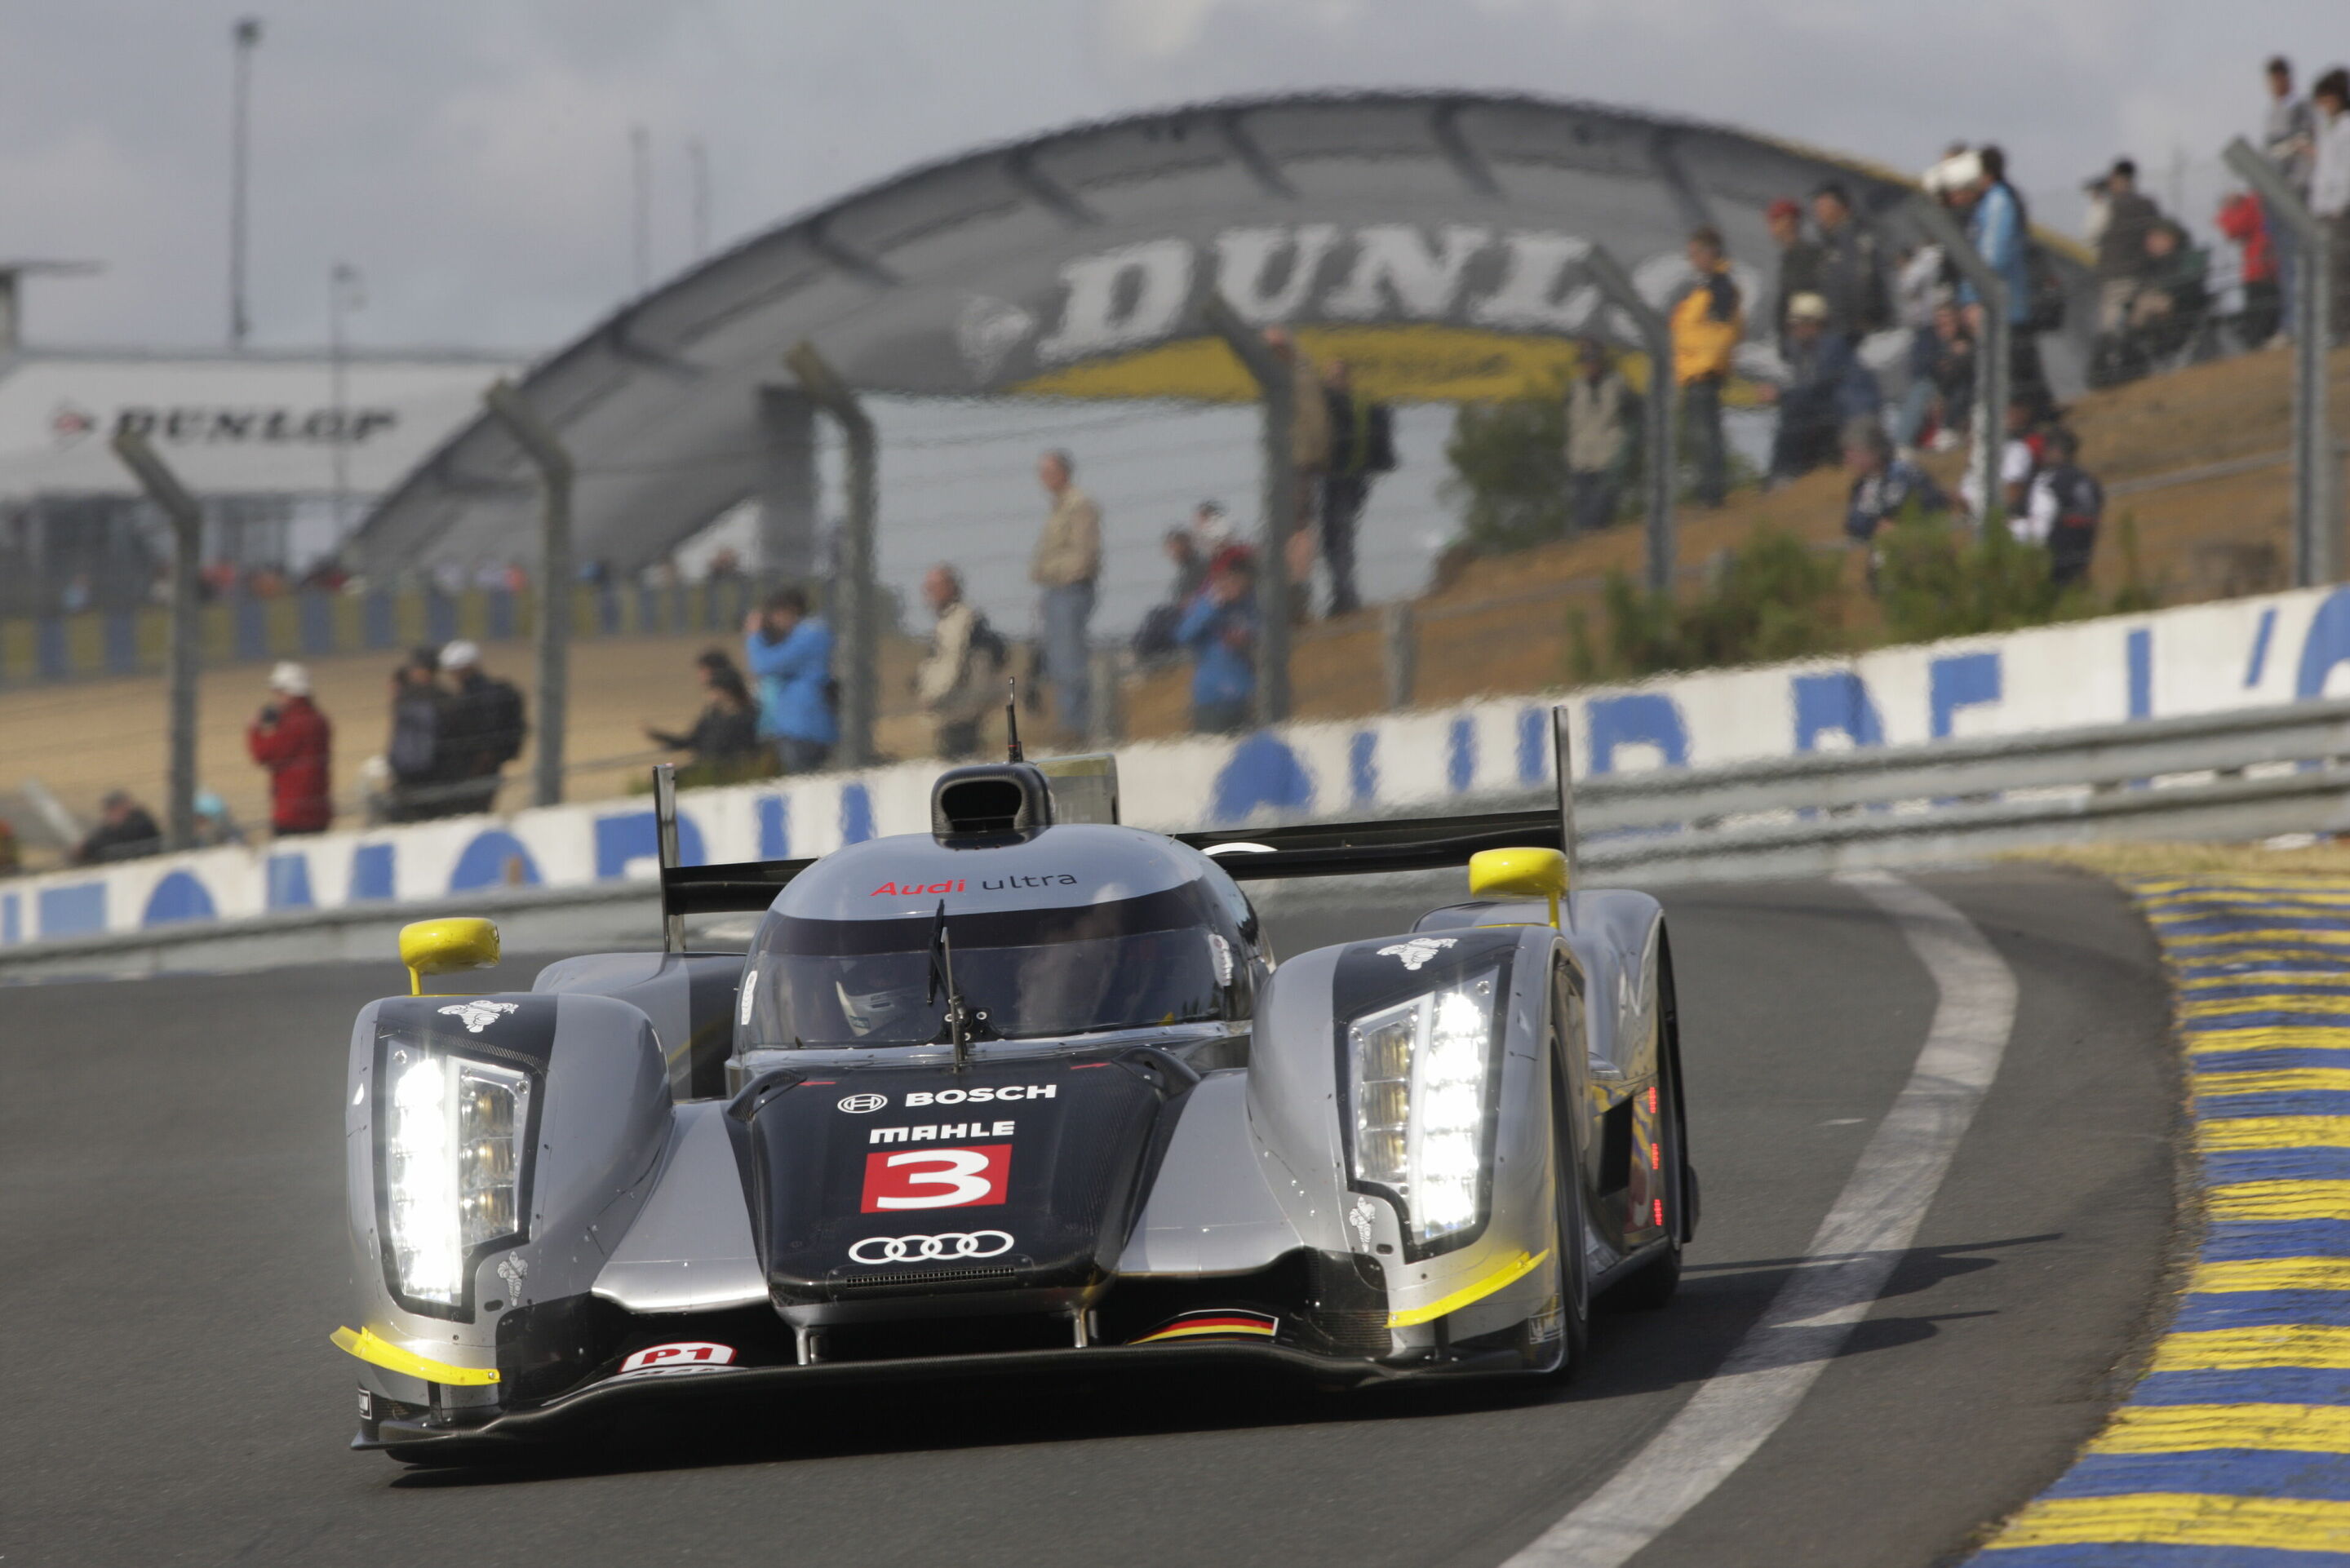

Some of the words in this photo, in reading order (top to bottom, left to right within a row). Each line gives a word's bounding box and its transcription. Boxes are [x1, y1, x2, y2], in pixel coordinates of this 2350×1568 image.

[113, 405, 400, 444] DUNLOP
[869, 879, 966, 897] Audi
[982, 870, 1077, 891] ultra
[905, 1084, 1058, 1107] BOSCH
[869, 1120, 1015, 1145] MAHLE
[877, 1149, 991, 1208] 3
[641, 1348, 713, 1364] P1
